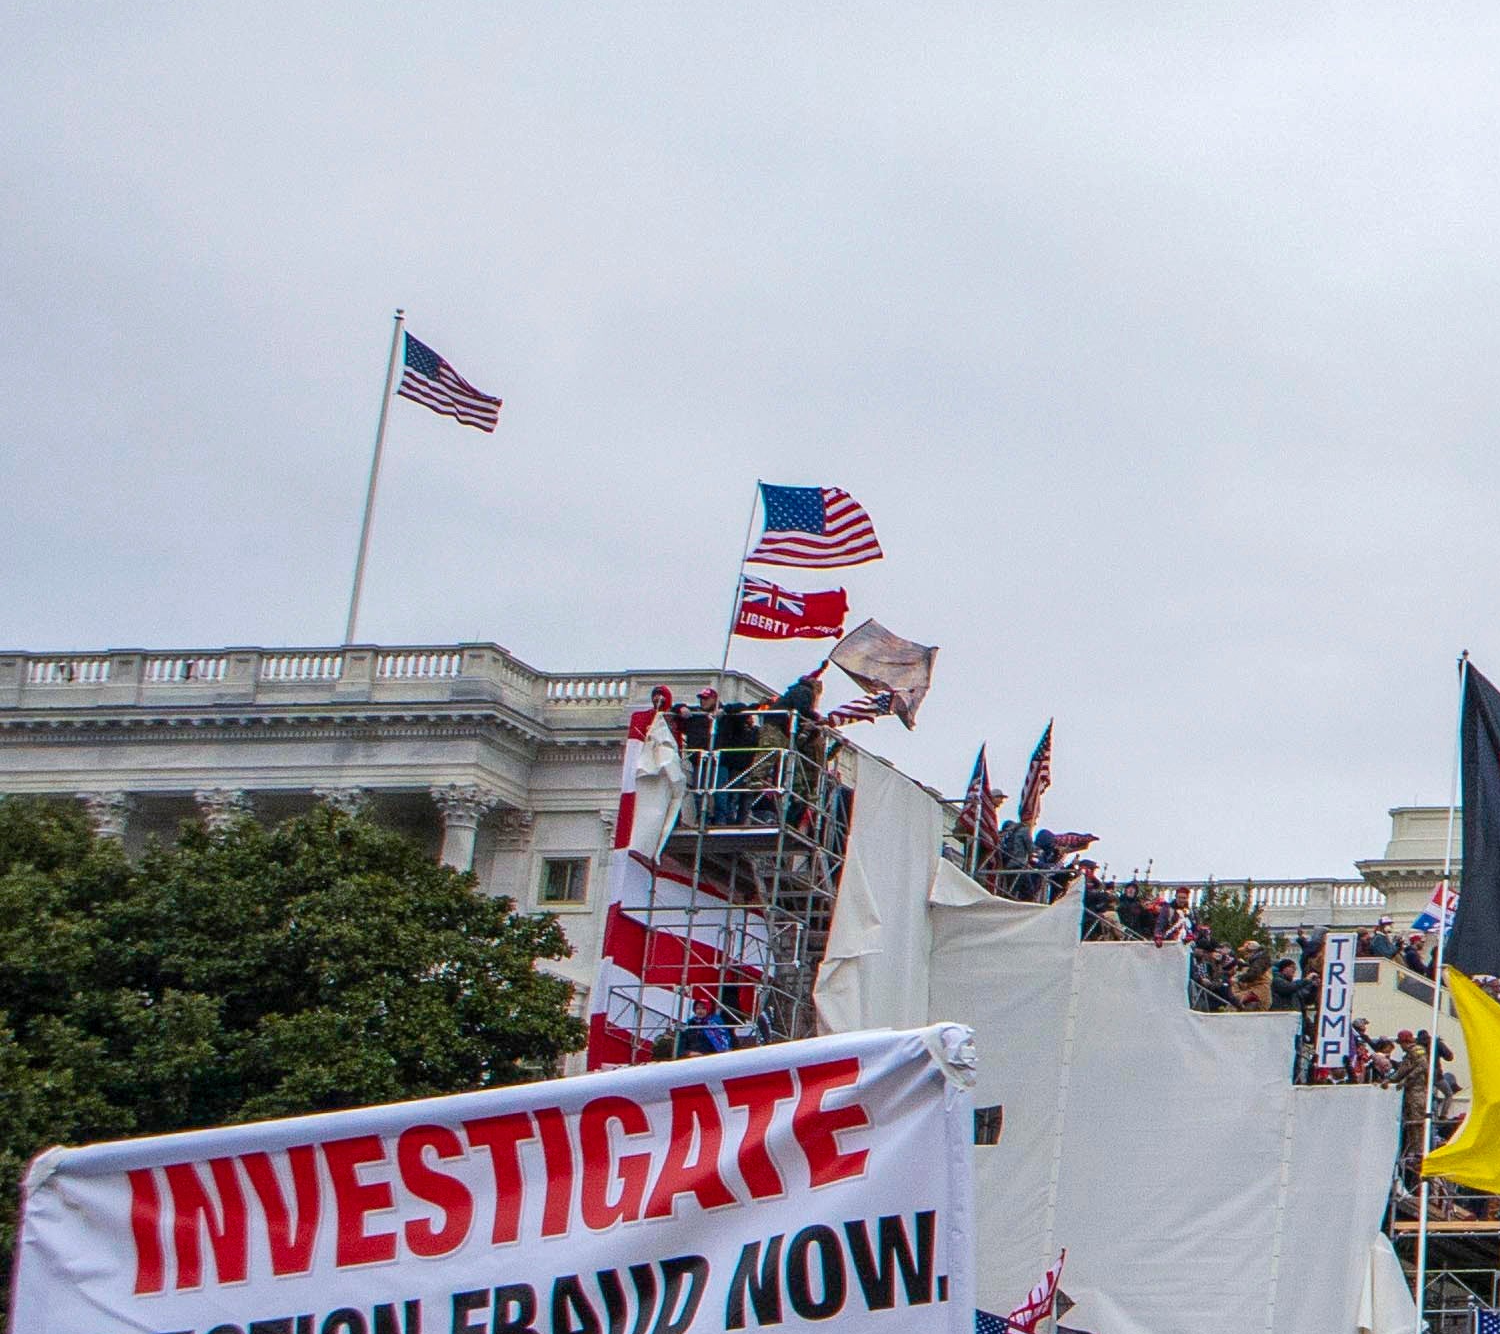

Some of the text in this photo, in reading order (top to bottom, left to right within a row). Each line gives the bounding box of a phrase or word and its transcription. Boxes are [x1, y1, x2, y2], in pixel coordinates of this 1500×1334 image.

[740, 612, 790, 635] LIBERTY
[127, 1057, 871, 1295] INVESTIGATE
[726, 1210, 949, 1332] NOW.
